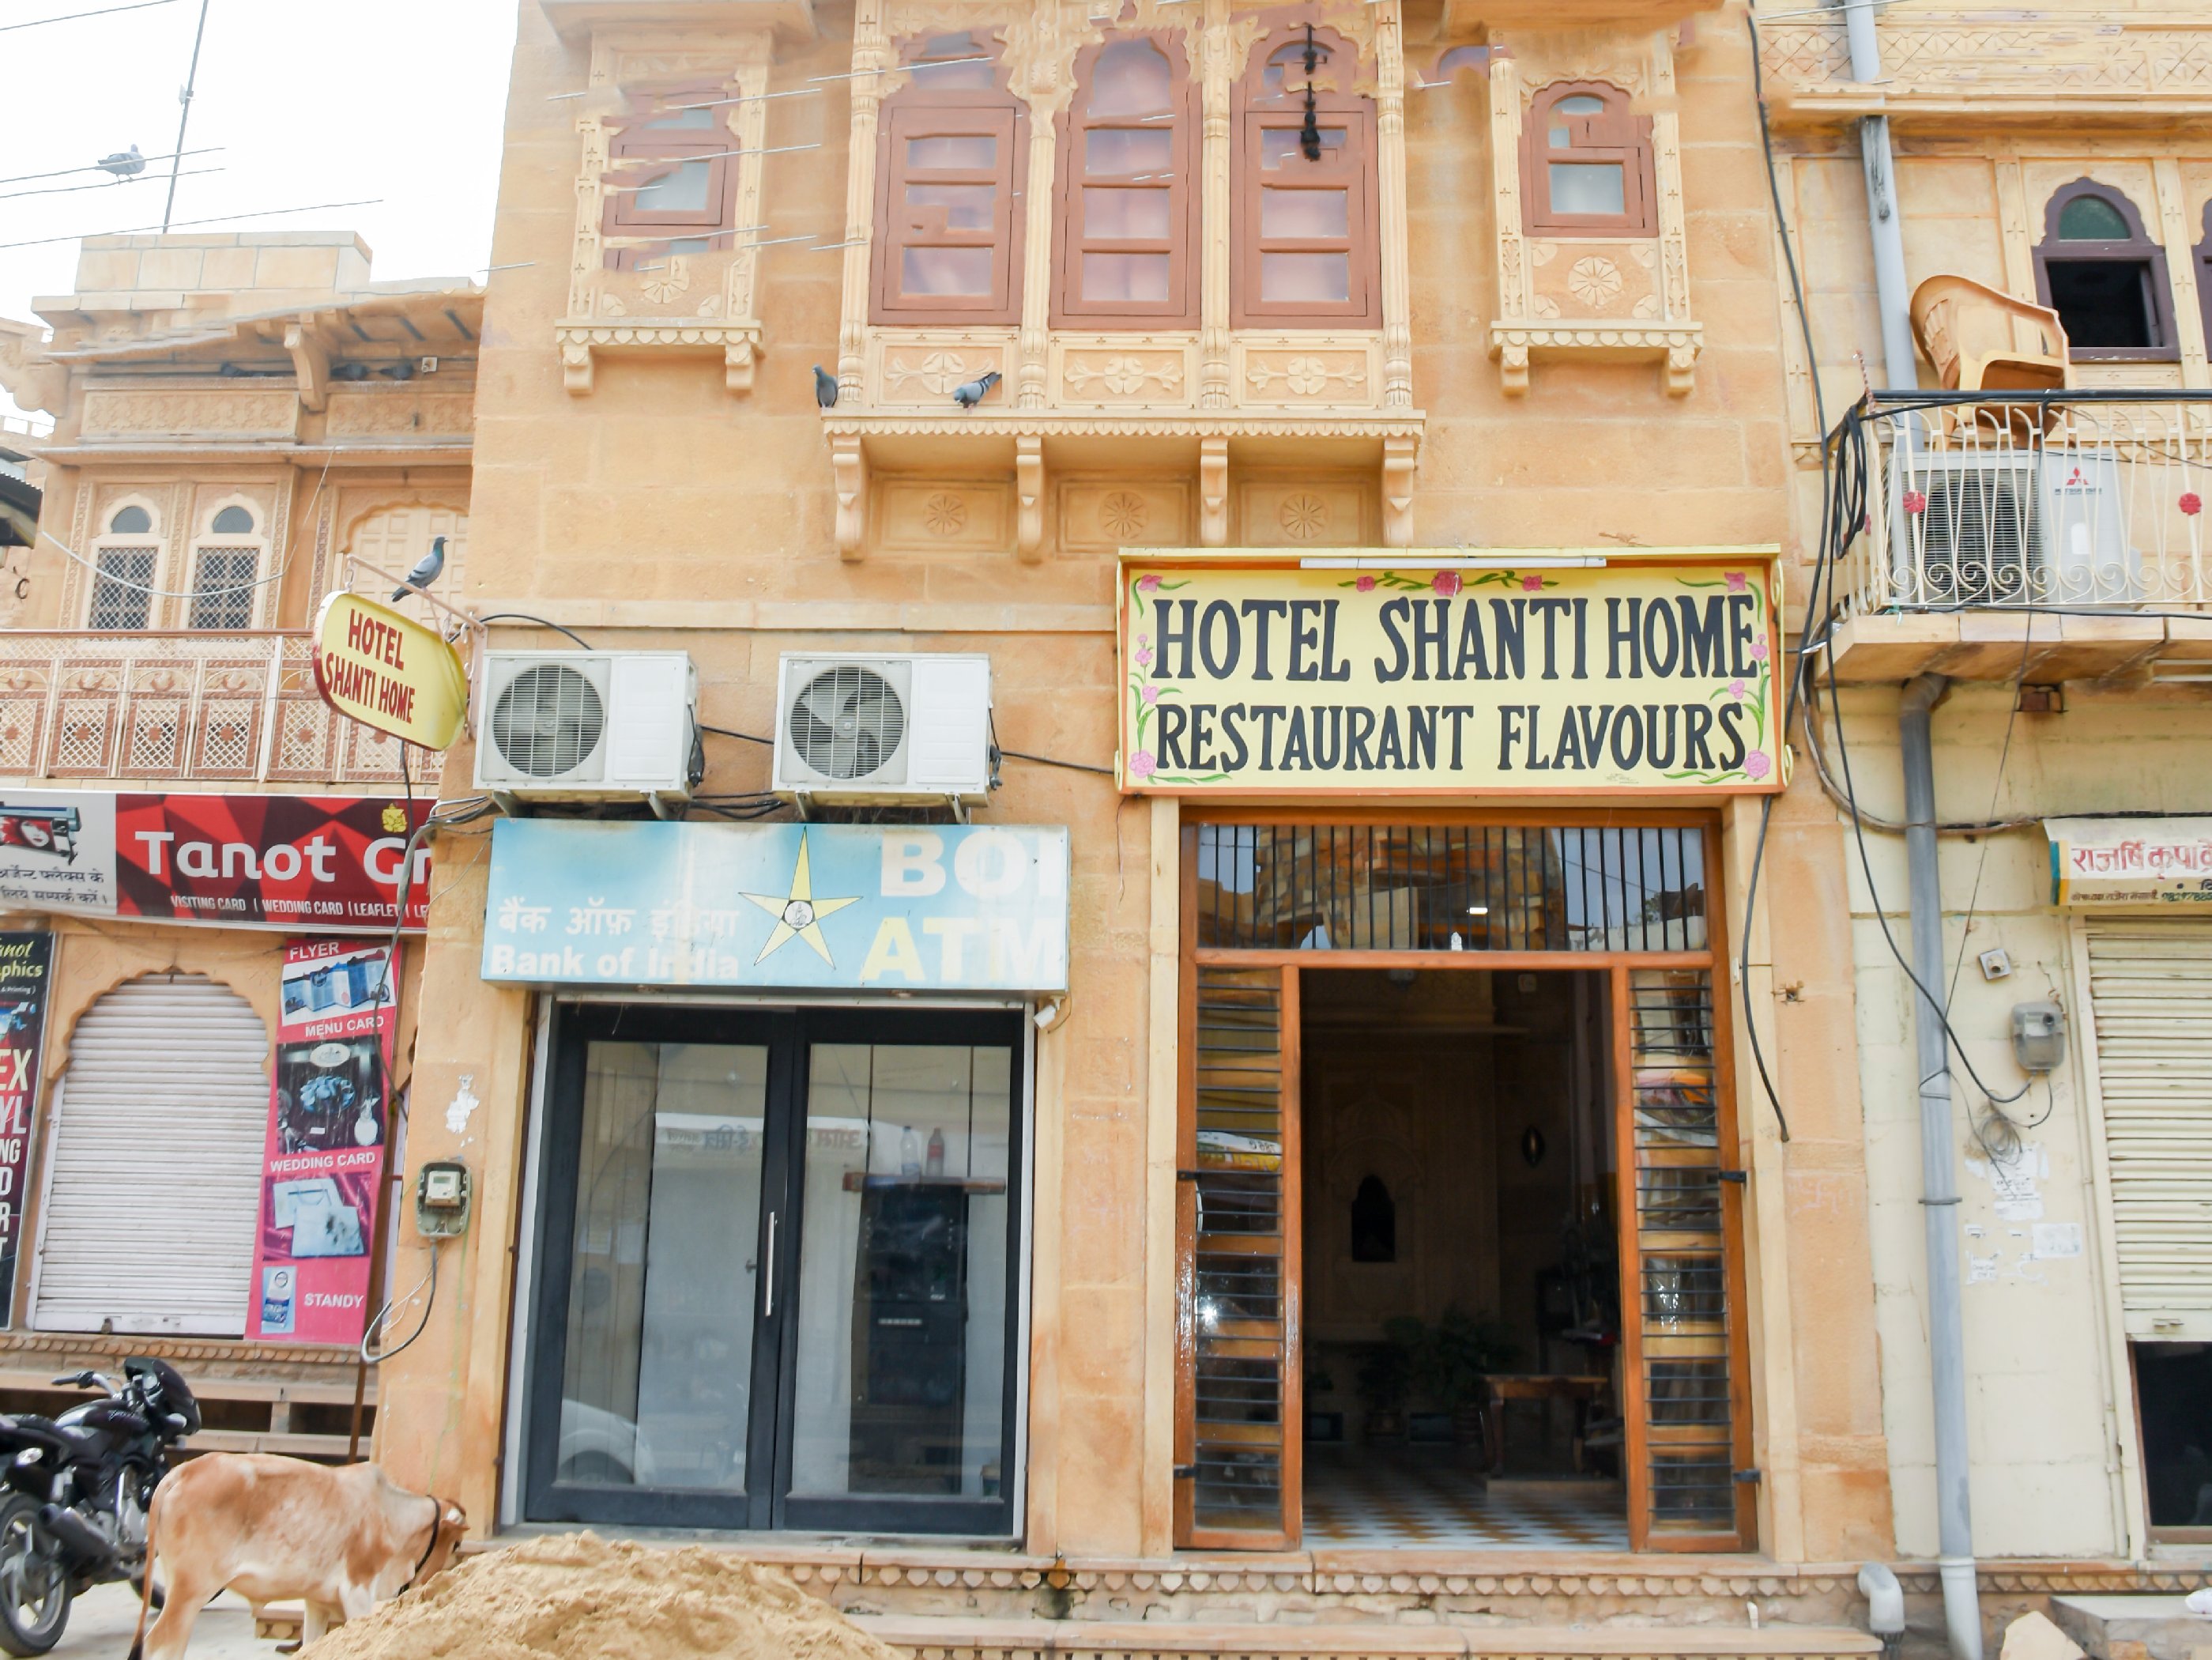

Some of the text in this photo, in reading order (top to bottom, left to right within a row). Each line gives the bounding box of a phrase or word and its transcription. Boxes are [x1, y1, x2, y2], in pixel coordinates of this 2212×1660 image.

[348, 609, 405, 671] HOTEL
[1151, 594, 1758, 683] HOTEL SHANTI HOME
[326, 652, 416, 724] SHANTI HOME
[1155, 703, 1747, 772] RESTAURANT FLAVOURS
[134, 831, 337, 882] Tanot
[880, 830, 1062, 897] BOI
[171, 896, 216, 910] VISITING
[217, 897, 246, 911] CARD
[262, 899, 311, 914] WEDDING
[314, 900, 343, 915] CARD
[353, 903, 399, 917] LEAFLET
[498, 896, 552, 934] बैंक
[289, 941, 340, 960] FLYER
[490, 944, 740, 980] Bank of India
[857, 917, 1063, 983] ATM
[0, 960, 43, 983] phics
[305, 1016, 384, 1037] MENU CARD
[270, 1152, 375, 1173] WEDDING CARD
[304, 1292, 364, 1309] STANDY
